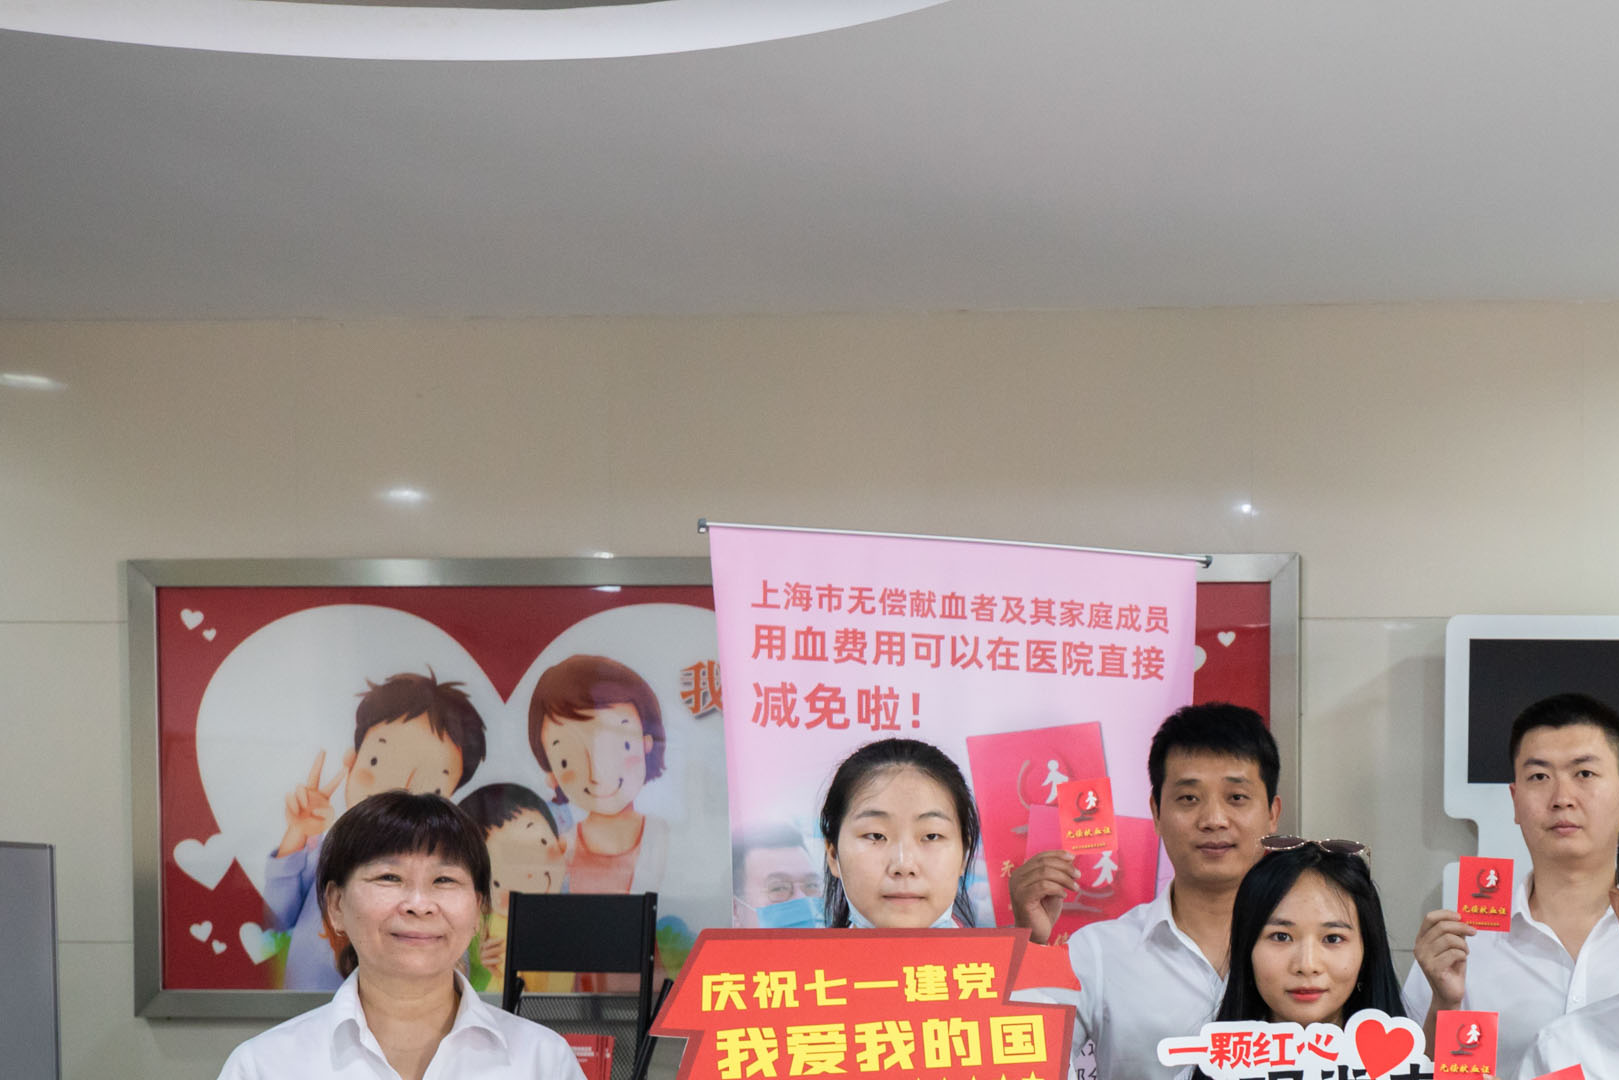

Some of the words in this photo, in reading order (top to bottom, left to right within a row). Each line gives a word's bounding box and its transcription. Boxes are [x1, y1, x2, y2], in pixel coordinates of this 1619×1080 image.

[751, 580, 1169, 634] 上海市无偿献血者及其家庭成员
[751, 624, 1165, 681] 用血费用可以在医院直接
[701, 963, 998, 1012] 庆祝七一建党
[716, 1015, 1047, 1080] 我爱我的国
[1169, 1031, 1339, 1069] 一颗红心
